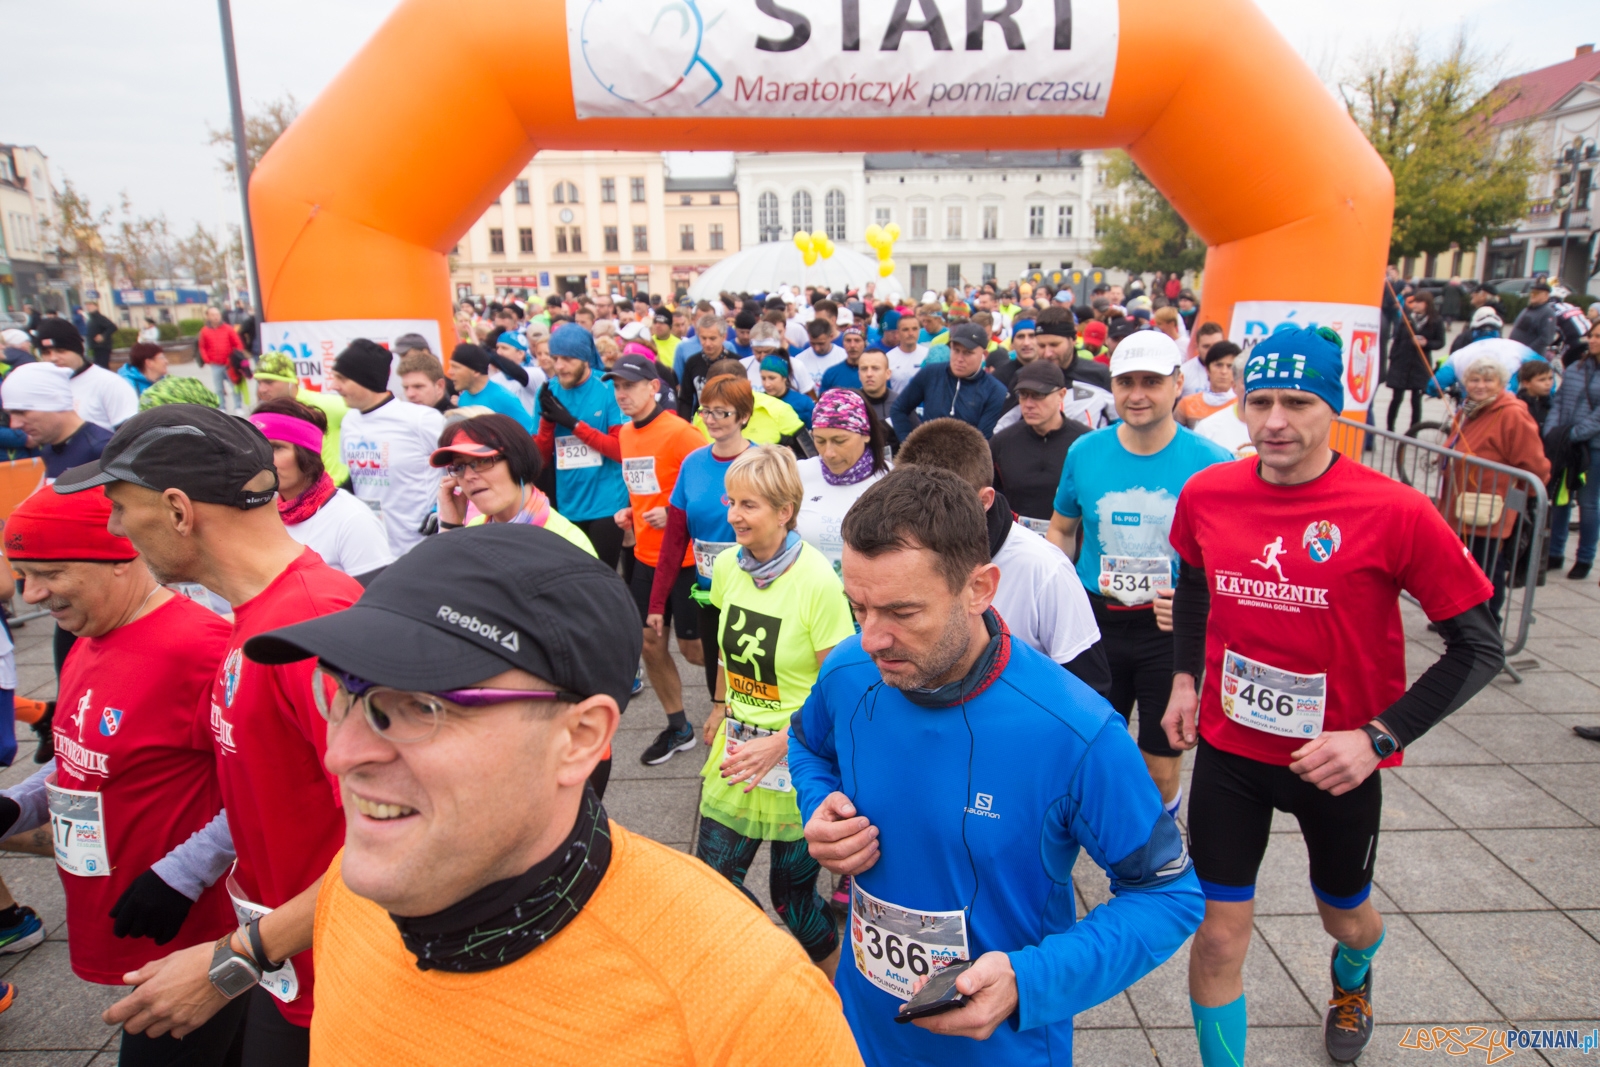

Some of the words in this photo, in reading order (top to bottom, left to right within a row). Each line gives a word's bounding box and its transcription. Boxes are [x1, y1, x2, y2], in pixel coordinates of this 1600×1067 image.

[734, 73, 919, 108] Maratończyk
[927, 74, 1101, 108] pomiarczasu
[566, 446, 588, 458] 520
[629, 471, 645, 484] 387
[1113, 574, 1151, 592] 534
[1238, 599, 1273, 610] MUROWANA
[1273, 603, 1301, 613] GOŚLINA
[436, 605, 502, 642] Reebok
[733, 675, 768, 697] night
[731, 689, 782, 712] runners
[1239, 683, 1294, 717] 466
[1240, 715, 1268, 728] POLINOVA
[1269, 725, 1294, 734] POLSKA
[865, 925, 929, 976] 366
[873, 974, 905, 994] POLINOVA
[885, 969, 909, 985] Artur
